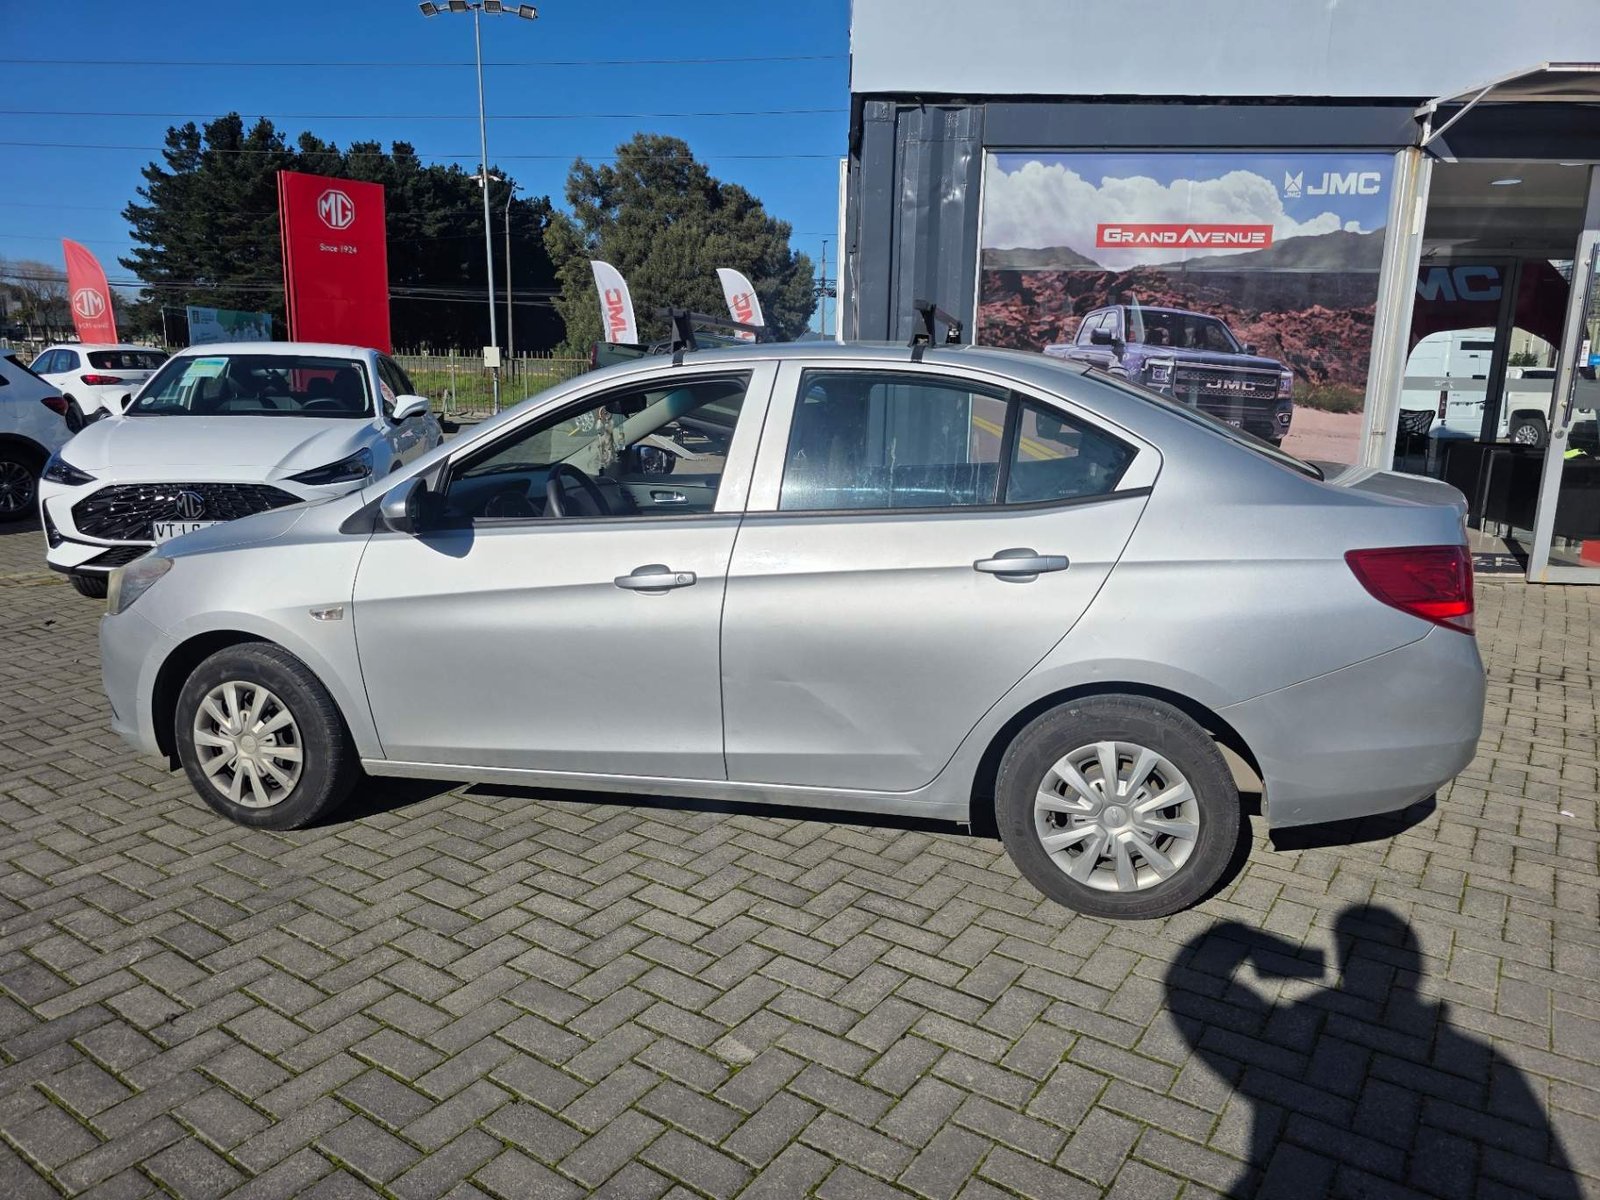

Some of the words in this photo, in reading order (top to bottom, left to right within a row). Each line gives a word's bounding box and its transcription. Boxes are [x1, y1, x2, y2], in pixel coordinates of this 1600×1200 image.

[1307, 172, 1381, 195] JMC
[320, 192, 352, 227] MG
[1103, 228, 1178, 244] GRAND
[1179, 228, 1266, 244] AVENUE
[320, 243, 338, 252] Since
[340, 245, 357, 254] 1924
[1206, 379, 1256, 391] JMC
[176, 494, 202, 517] MG
